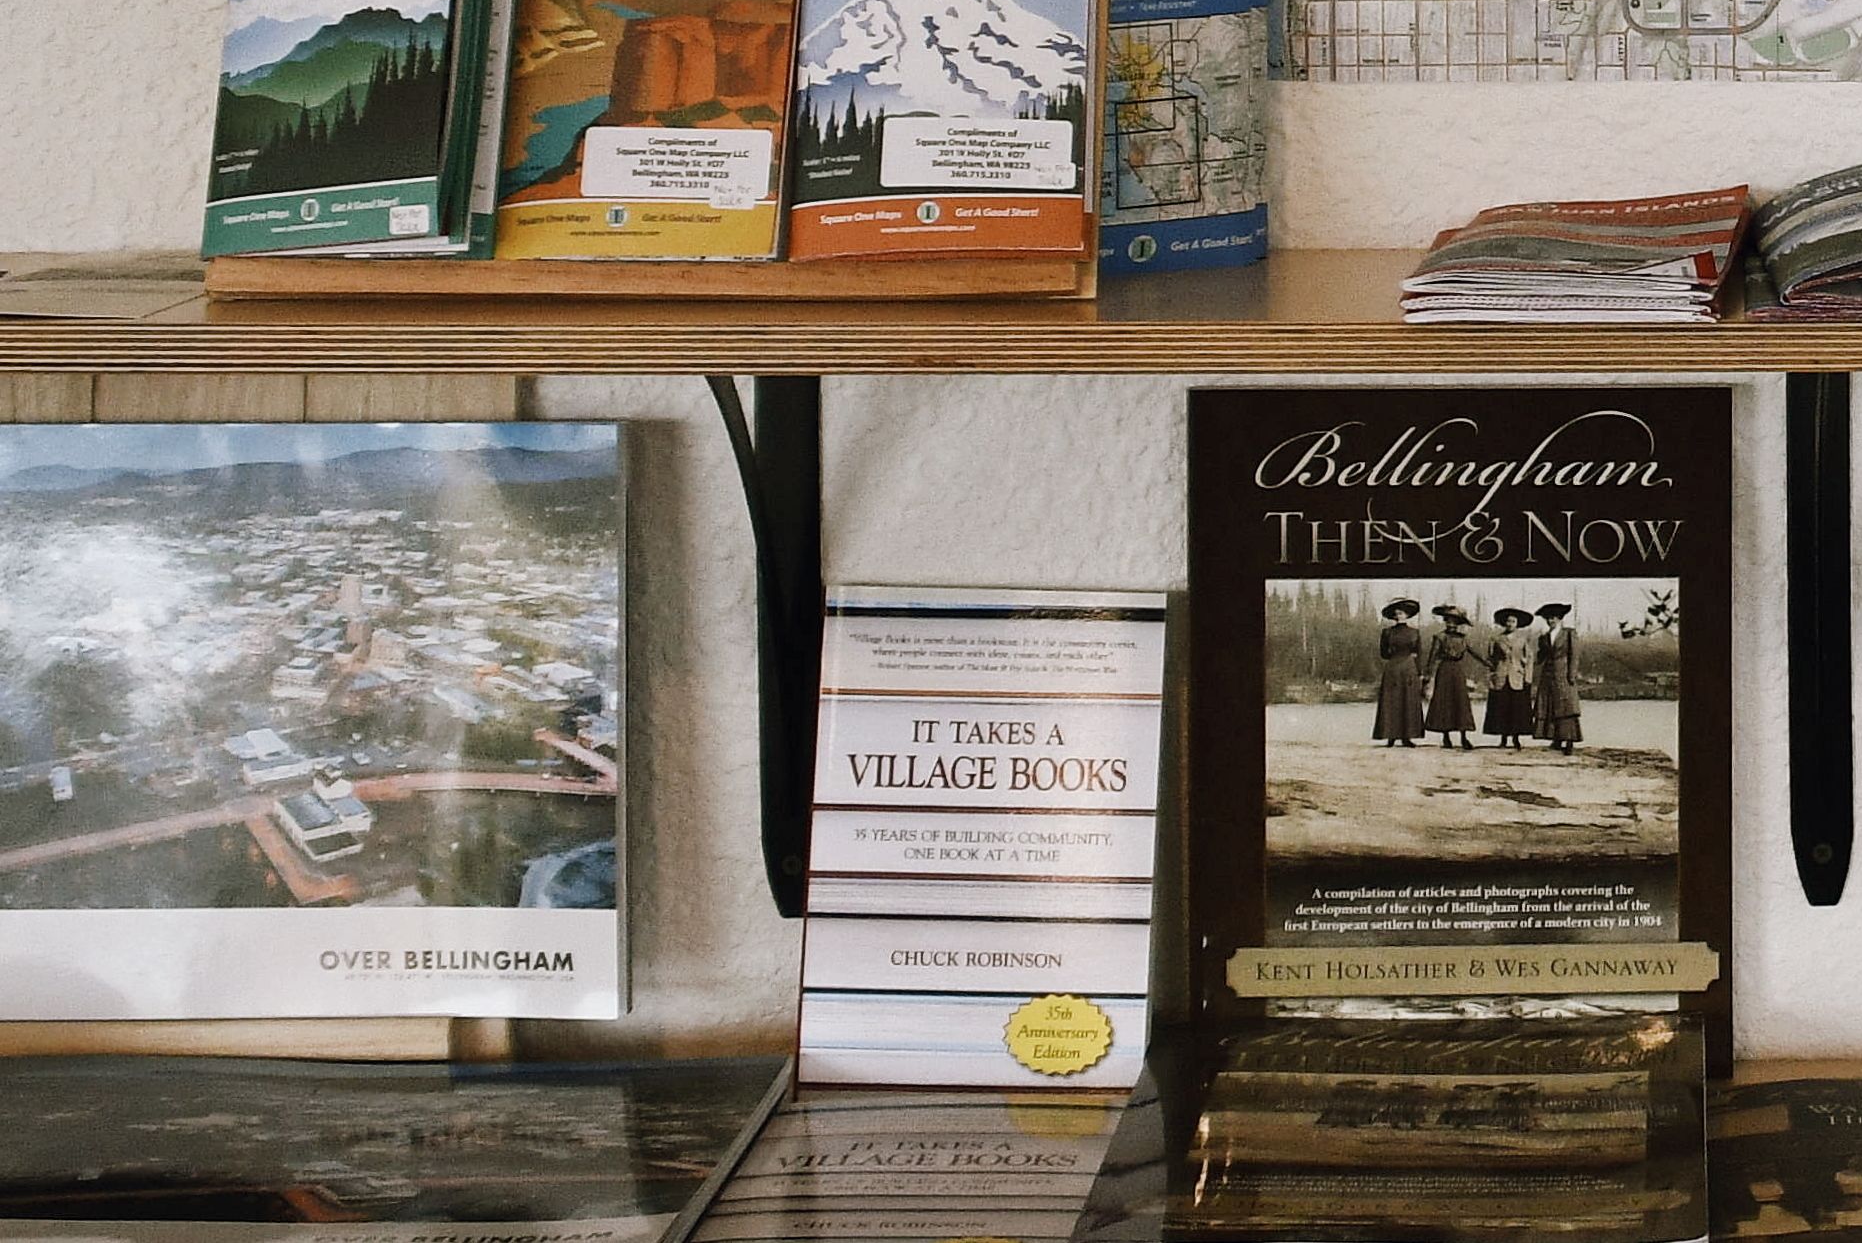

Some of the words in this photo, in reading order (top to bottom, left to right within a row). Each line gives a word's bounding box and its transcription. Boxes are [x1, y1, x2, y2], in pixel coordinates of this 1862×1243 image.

[1254, 410, 1673, 529] Bellingham
[1264, 511, 1438, 564] THEN
[1458, 512, 1504, 564] &
[1522, 510, 1684, 563] NOW
[912, 719, 940, 744] IT
[949, 719, 1035, 746] TAKES
[1045, 723, 1064, 746] A
[848, 753, 997, 791] VILLAGE
[1008, 757, 1127, 792] BOOKS
[1312, 888, 1322, 899] A
[1324, 887, 1396, 901] compilation
[1398, 886, 1411, 899] of
[1413, 886, 1457, 899] articles
[1459, 886, 1481, 898] and
[1484, 886, 1559, 900] photographs
[1561, 886, 1613, 899] covering
[1615, 885, 1634, 896] the
[319, 950, 392, 971] OVER
[403, 949, 575, 972] BELLINGHAM
[890, 950, 959, 967] CHUCK
[966, 951, 1062, 969] ROBINSON
[1256, 961, 1313, 981] KENT
[1325, 960, 1458, 980] HOLSATHER
[1468, 959, 1486, 978] &
[1495, 959, 1541, 978] WES
[1550, 957, 1679, 978] GANNAWAY
[1045, 1005, 1073, 1021] 35th
[1016, 1024, 1099, 1042] Anniversary
[1032, 1045, 1081, 1060] Edition
